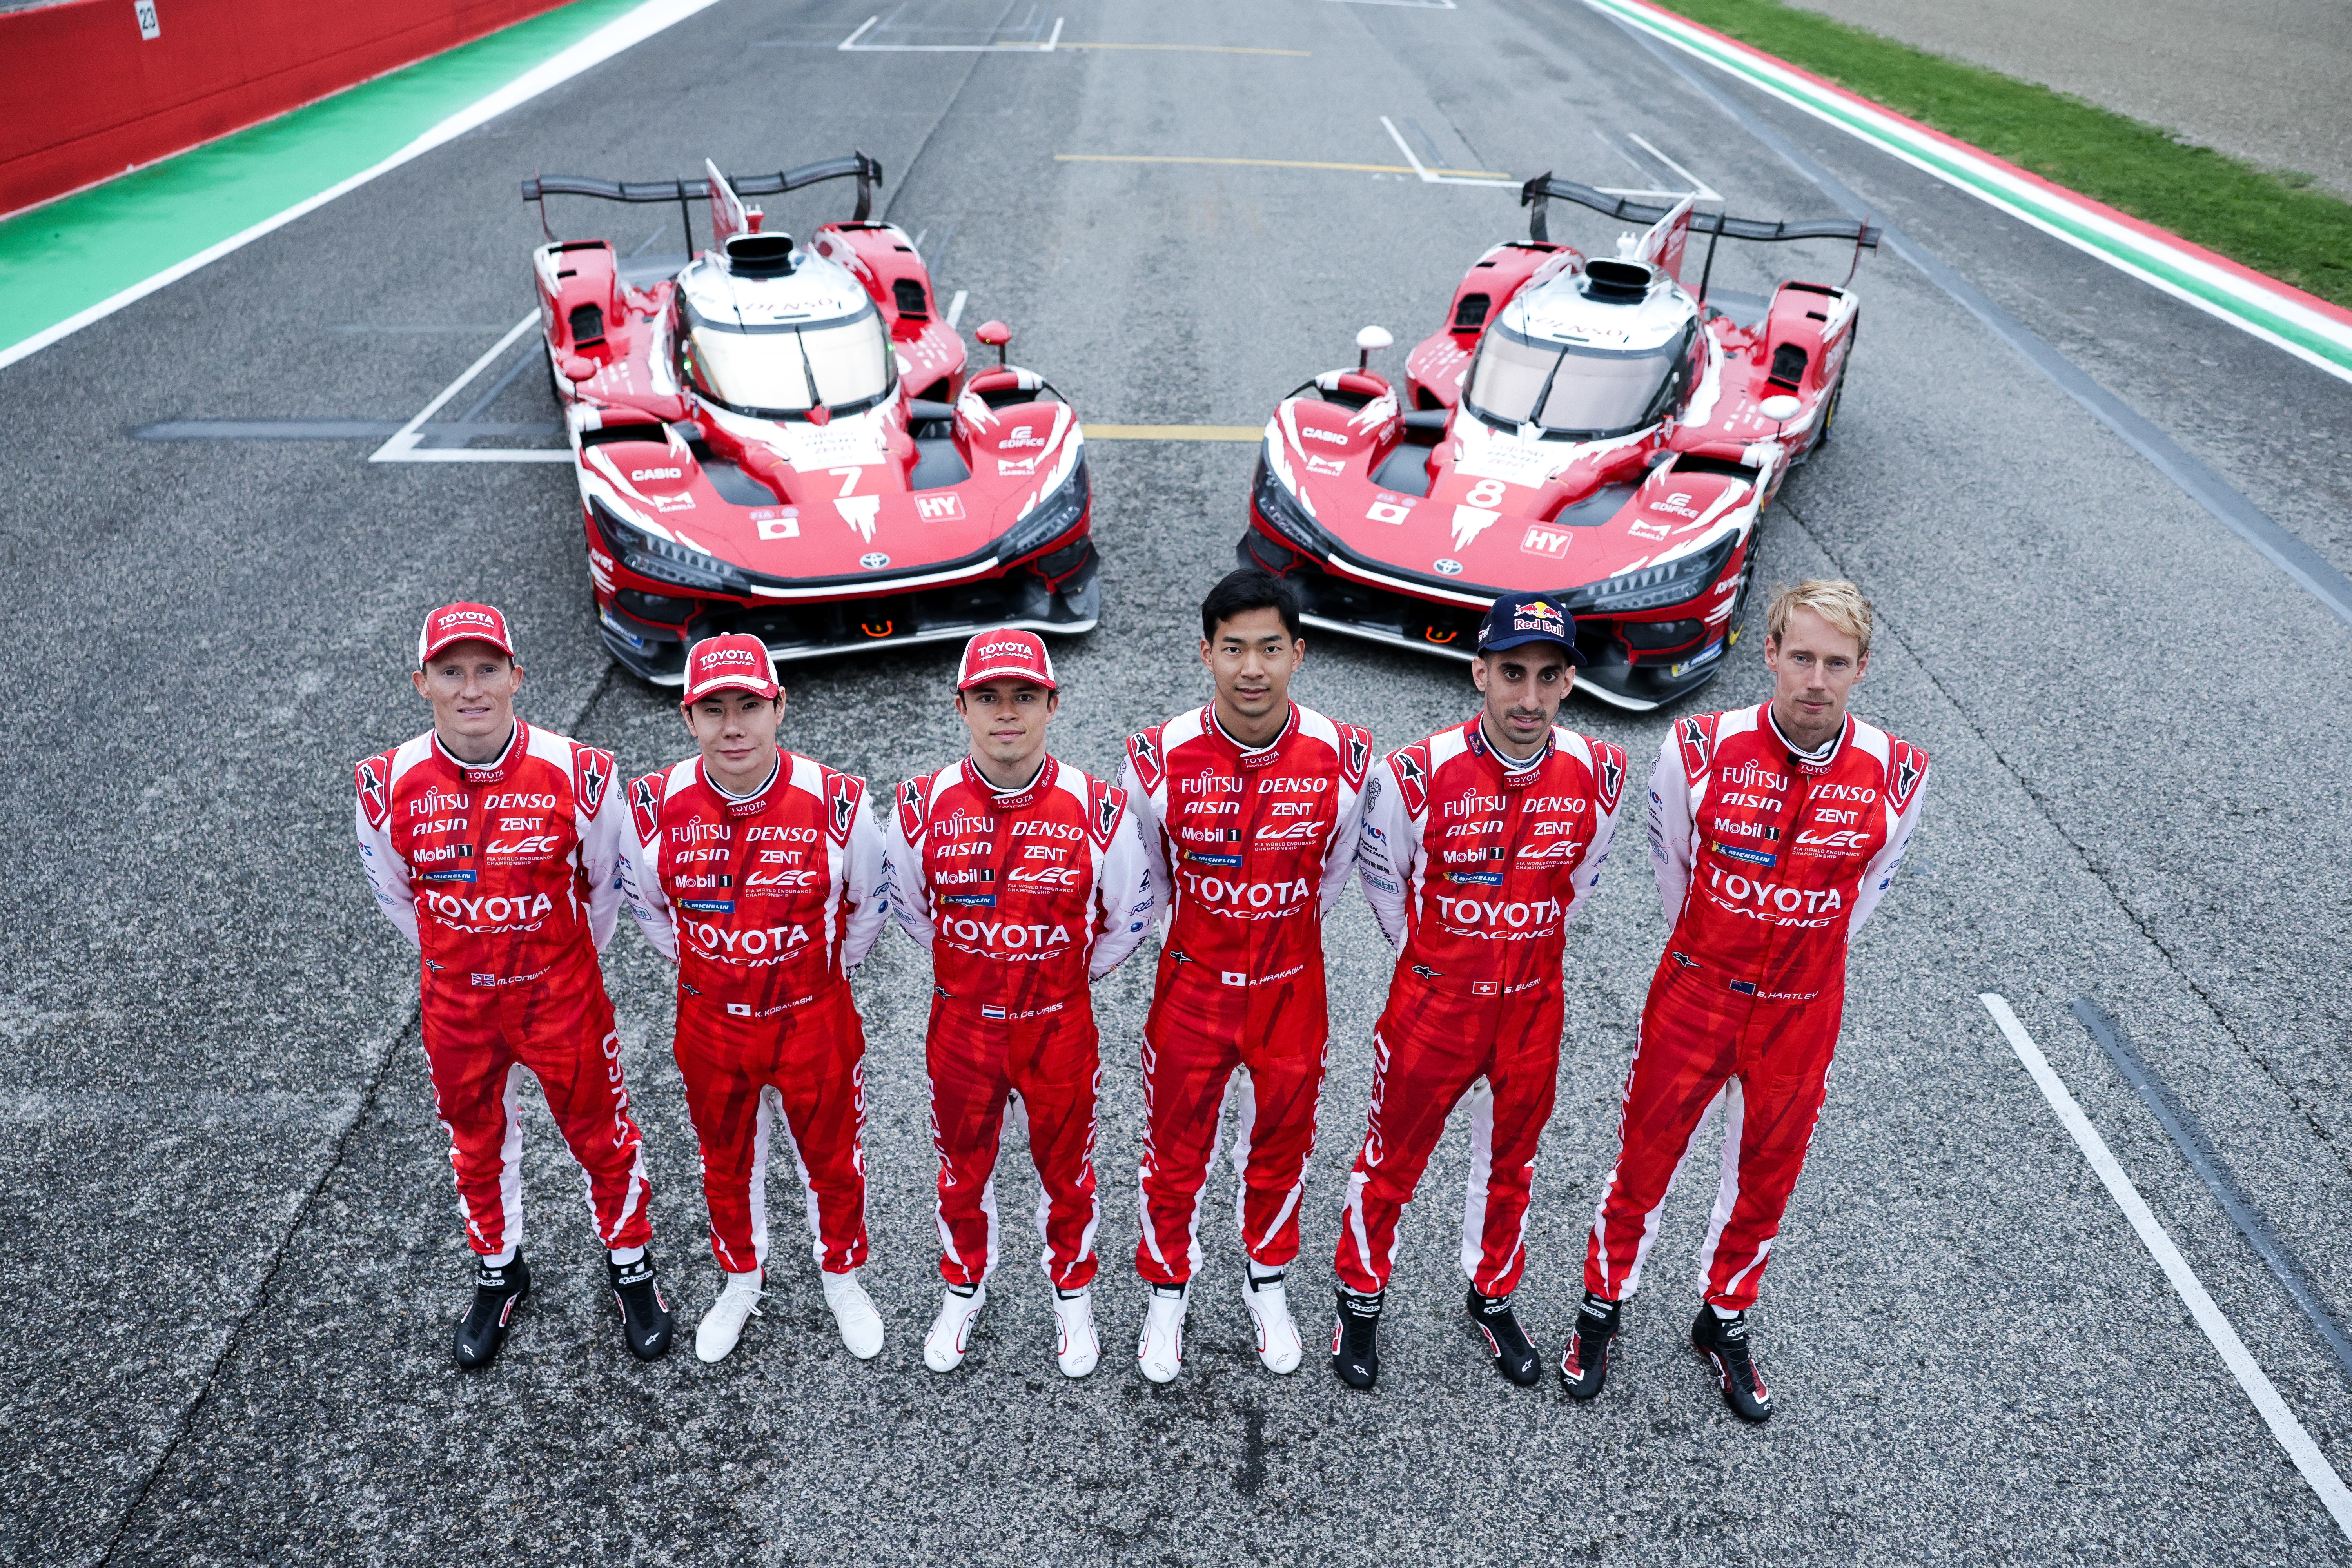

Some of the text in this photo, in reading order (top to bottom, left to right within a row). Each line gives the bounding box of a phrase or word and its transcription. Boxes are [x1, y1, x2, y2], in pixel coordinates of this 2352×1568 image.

[140, 8, 155, 29] 23
[999, 438, 1045, 449] EDIFICE
[1302, 427, 1348, 445] CASIO
[631, 468, 682, 482] CASIO
[829, 466, 862, 497] 7
[1466, 479, 1506, 508] 8
[918, 496, 956, 518] HY
[1650, 502, 1699, 519] EDIFICE
[1525, 530, 1568, 553] HY
[1627, 529, 1664, 542] MARELLI
[438, 611, 494, 626] TOYOTA
[439, 620, 494, 630] RACING
[1514, 618, 1564, 637] Red Bull
[699, 650, 755, 666] TOYOTA
[978, 642, 1033, 657] TOYOTA
[979, 652, 1033, 661] RACING
[701, 661, 755, 671] RACING
[1243, 751, 1279, 764] TOYOTA
[1245, 759, 1278, 768] RACING
[467, 769, 504, 779] TOYOTA
[1181, 767, 1243, 797] FUJITSU
[1506, 769, 1540, 783] TOYOTA
[1510, 778, 1539, 787] RACING
[1722, 759, 1788, 791] FUJITSU
[1258, 777, 1327, 794] DENSO
[410, 786, 469, 818] FUJITSU
[483, 793, 557, 809] DENSO
[730, 800, 767, 813] TOYOTA
[996, 794, 1034, 806] TOYOTA
[1184, 802, 1240, 814] AISIN
[1444, 788, 1506, 820] FUJITSU
[1522, 797, 1586, 813] DENSO
[1721, 792, 1782, 813] AISIN
[733, 808, 766, 817] RACING
[1271, 802, 1314, 816] ZENT
[1814, 808, 1859, 825] ZENT
[412, 818, 468, 837] AISIN
[499, 817, 543, 831] ZENT
[671, 815, 730, 846] FUJITSU
[934, 808, 994, 840] FUJITSU
[1011, 821, 1083, 841] DENSO
[1255, 821, 1325, 839] WEC
[1445, 821, 1503, 837] AISIN
[1534, 822, 1574, 836] ZENT
[1715, 817, 1762, 838] Mobil
[746, 826, 818, 843] DENSO
[1182, 826, 1223, 842] Mobil
[1795, 829, 1871, 849] WEC
[486, 835, 559, 854] WEC
[936, 842, 993, 858] AISIN
[1517, 841, 1582, 858] WEC
[414, 844, 455, 863] Mobil
[675, 849, 730, 864] AISIN
[760, 850, 802, 864] ZENT
[1024, 846, 1067, 862] ZENT
[1443, 847, 1486, 863] Mobil
[1728, 850, 1770, 863] MICHELIN
[675, 874, 715, 888] Mobil
[746, 870, 817, 886] WEC
[936, 869, 977, 885] Mobil
[1008, 867, 1081, 885] WEC
[1183, 871, 1310, 907] TOYOTA
[1709, 862, 1841, 913] TOYOTA
[426, 889, 553, 922] TOYOTA
[1436, 894, 1561, 927] TOYOTA
[1705, 889, 1840, 927] RACING
[430, 913, 550, 934] RACING
[942, 914, 1071, 948] TOYOTA
[1436, 922, 1559, 940] RACING
[682, 916, 809, 955] TOYOTA
[687, 940, 808, 967] RACING
[940, 939, 1070, 962] RACING
[508, 965, 550, 983] CONWAY
[1259, 964, 1303, 984] HIRAKAWA
[1515, 977, 1541, 991] BUEMI
[1768, 991, 1818, 1000] HARTLEY
[764, 995, 813, 1016] KOBAYASHI
[1036, 1002, 1063, 1016] VRIES
